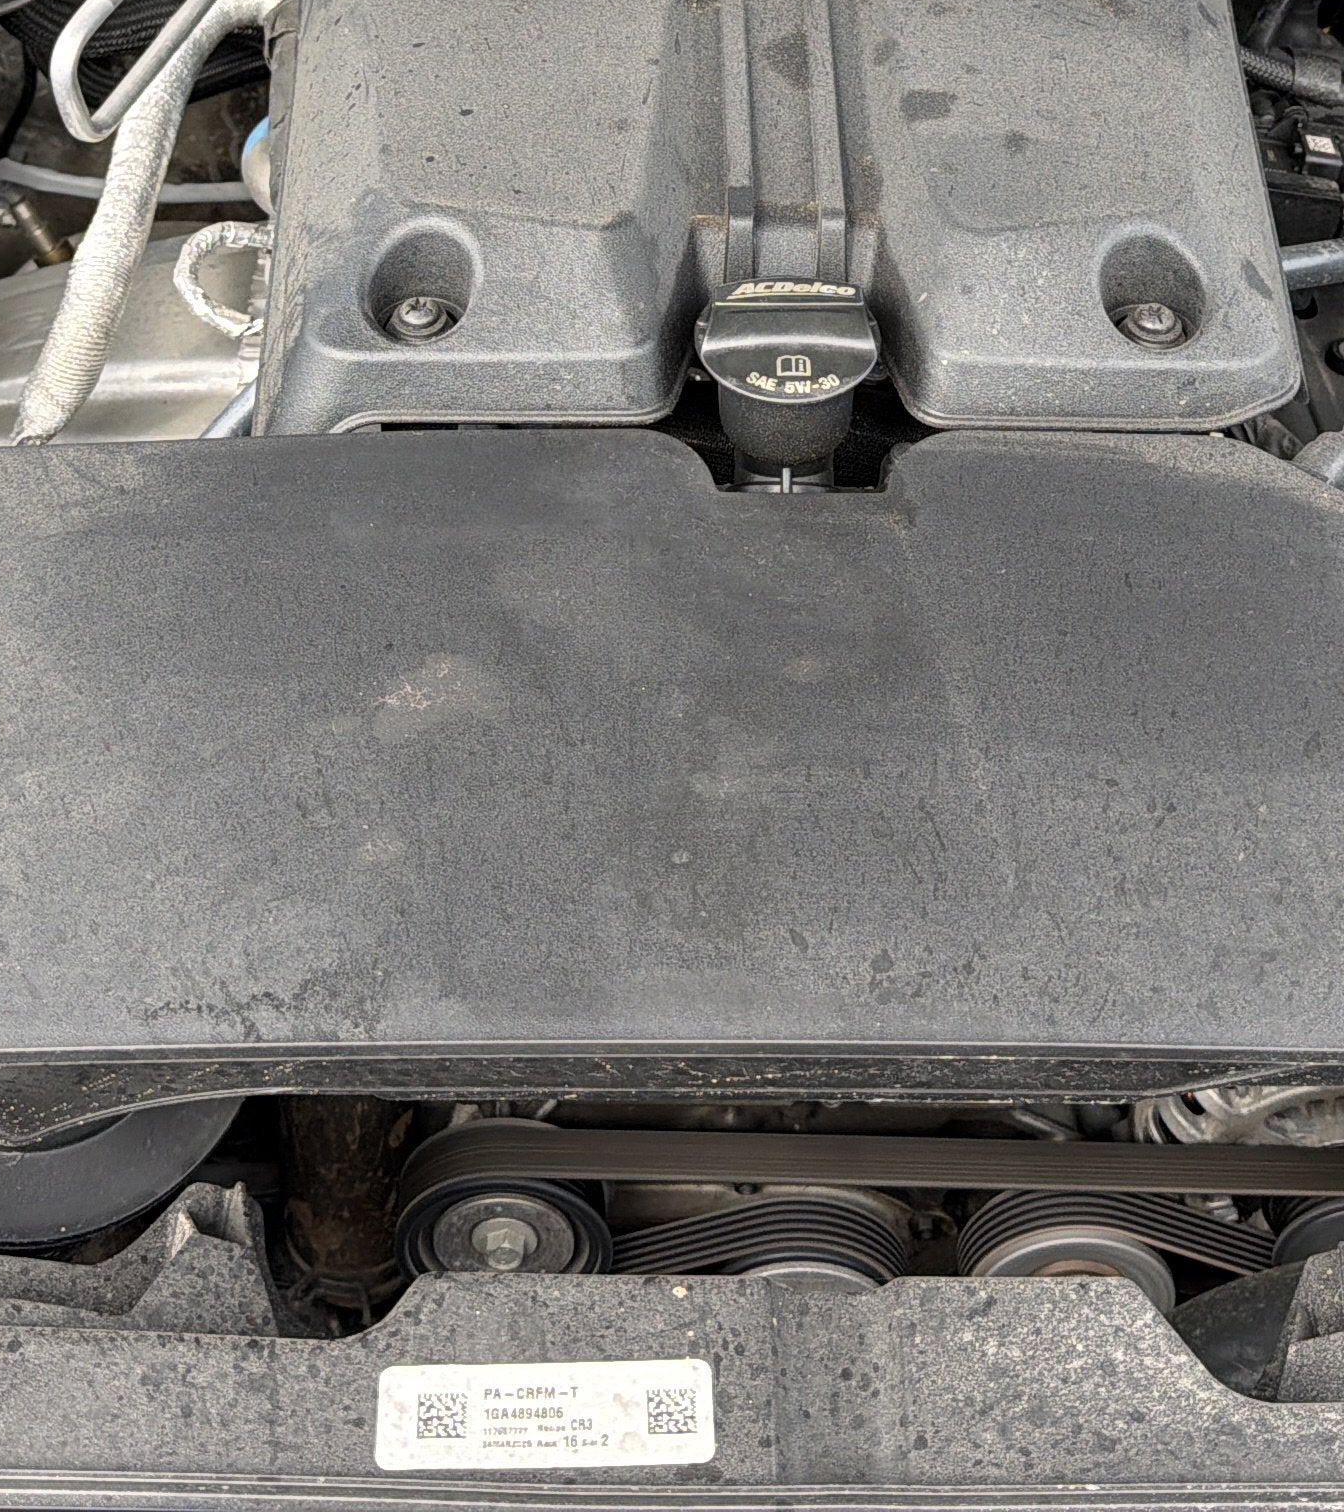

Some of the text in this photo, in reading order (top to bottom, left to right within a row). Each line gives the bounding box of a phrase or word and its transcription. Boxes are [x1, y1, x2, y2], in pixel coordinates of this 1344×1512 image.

[731, 281, 856, 296] ACDelco
[746, 371, 840, 394] SAE 5W-30
